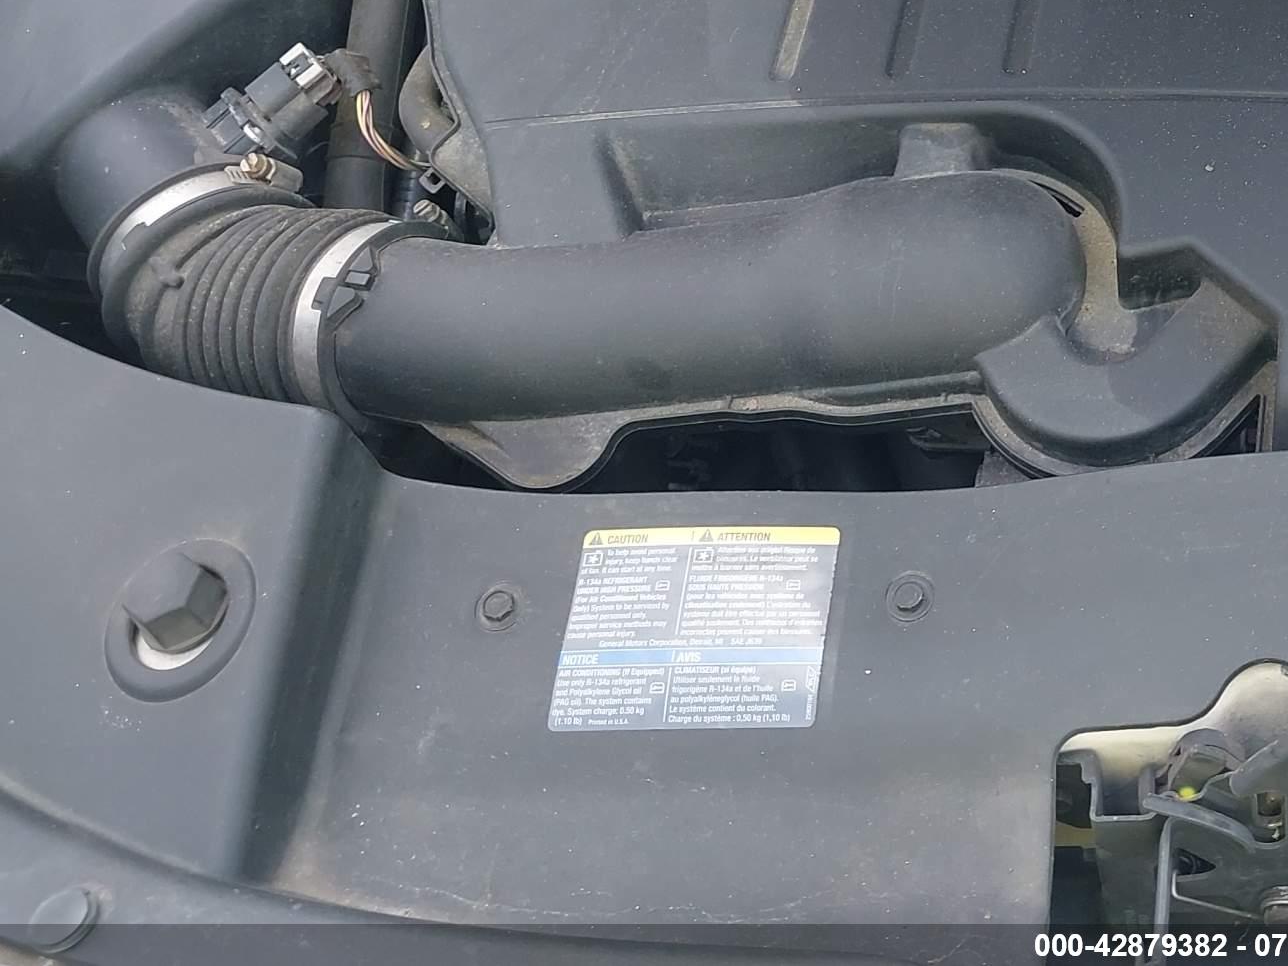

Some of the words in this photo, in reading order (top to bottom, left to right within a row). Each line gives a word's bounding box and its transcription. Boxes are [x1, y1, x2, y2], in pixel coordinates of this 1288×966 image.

[607, 533, 648, 544] CAUTION
[717, 532, 770, 541] ATTENTION
[562, 653, 599, 664] NOTICE
[676, 651, 702, 662] AVIS
[584, 697, 597, 705] The
[597, 697, 623, 705] system
[623, 696, 652, 704] contains
[567, 707, 592, 715] System
[618, 706, 635, 714] 0.50
[635, 706, 645, 714] kg
[668, 705, 677, 713] Le
[707, 704, 735, 712] contient
[736, 704, 745, 712] du
[746, 703, 777, 711] colorant.
[554, 717, 572, 725] (1.10
[667, 715, 691, 723] Charge
[692, 714, 702, 723] du
[752, 713, 762, 722] kg
